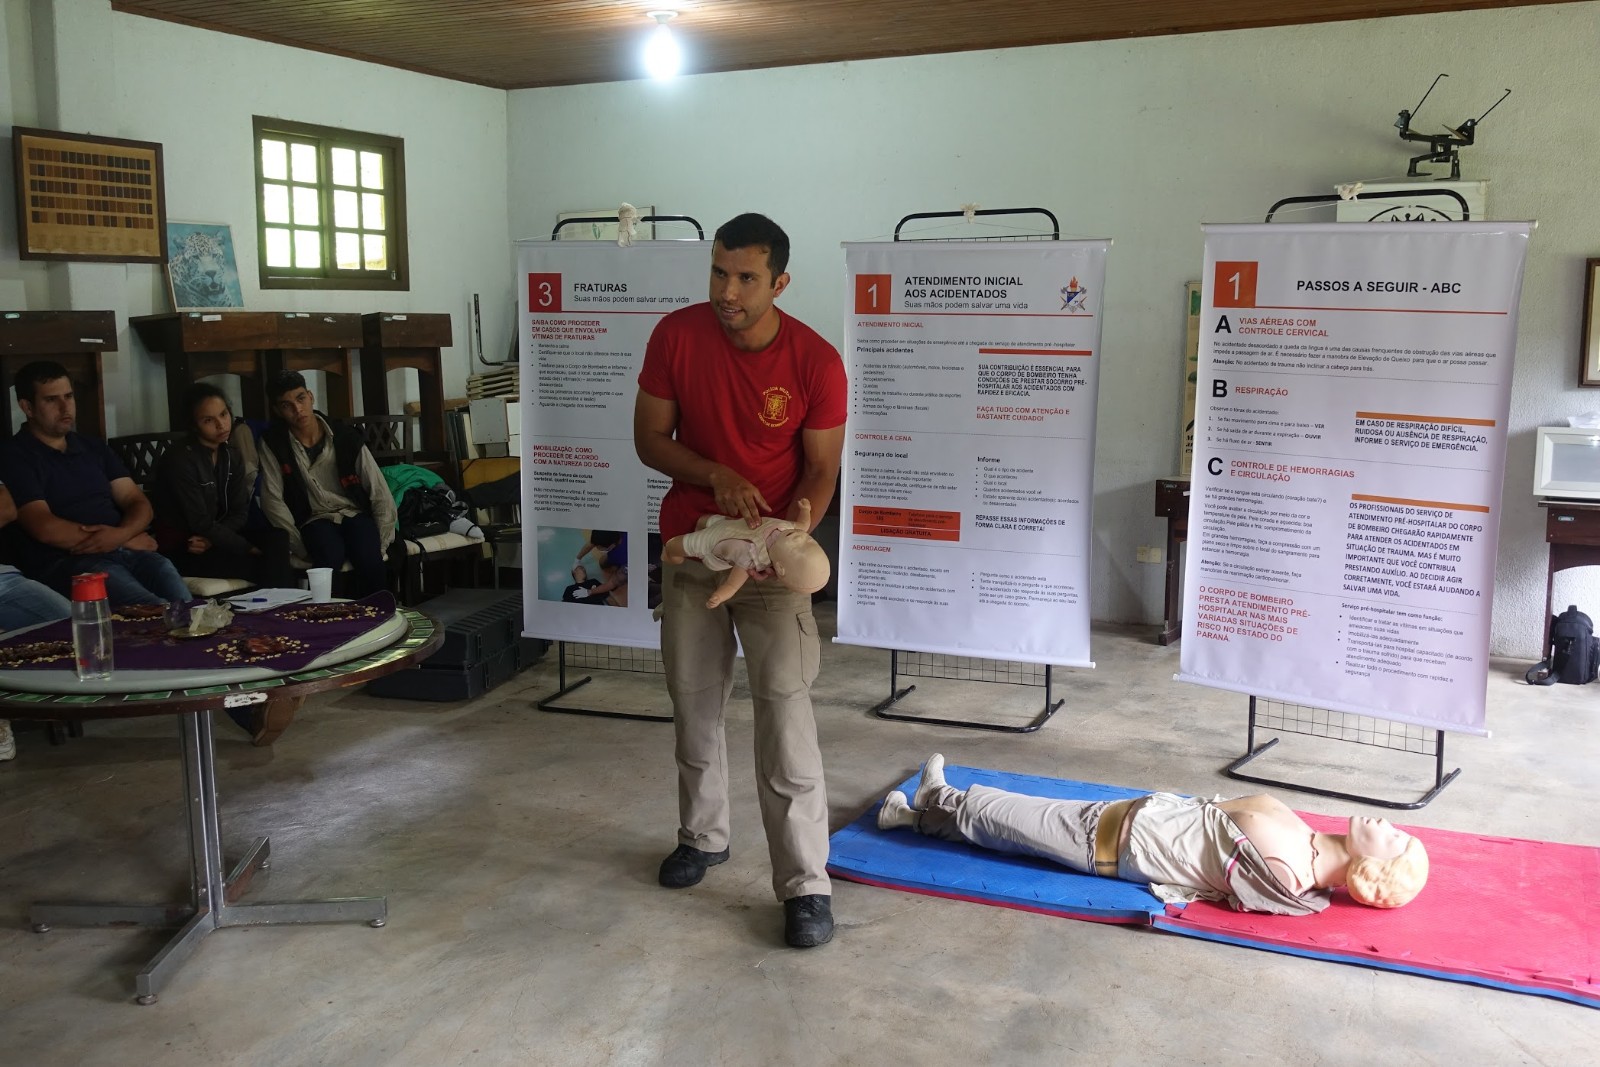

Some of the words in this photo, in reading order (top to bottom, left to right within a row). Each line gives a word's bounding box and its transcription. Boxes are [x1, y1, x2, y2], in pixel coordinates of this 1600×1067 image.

[574, 284, 627, 292] FRATURAS
[905, 277, 981, 285] ATENDIMENTO
[985, 277, 1023, 285] INICIAL
[1229, 272, 1240, 300] 1
[1297, 281, 1350, 291] PASSOS
[1353, 282, 1363, 291] A
[1367, 282, 1418, 292] SEGUIR
[1431, 283, 1461, 293] ABC
[539, 282, 552, 306] 3
[868, 284, 877, 307] 1
[905, 289, 926, 298] AOS
[930, 289, 1007, 298] ACIDENTADOS
[1215, 315, 1232, 333] A
[1260, 317, 1294, 326] AÉREAS
[1239, 327, 1283, 335] CONTROLE
[1286, 329, 1328, 337] CERVICAL
[1213, 379, 1227, 397] B
[1236, 387, 1288, 397] RESPIRAÇÃO
[1396, 422, 1439, 431] RESPIRAÇÃO
[1441, 423, 1466, 433] DIFÍCIL,
[1391, 439, 1419, 448] SERVIÇO
[1432, 442, 1478, 451] EMERGÊNCIA.
[1396, 431, 1429, 439] AUSÊNCIA
[1442, 434, 1488, 444] RESPIRAÇÃO,
[1208, 457, 1223, 476] C
[1231, 461, 1274, 470] CONTROLE
[1290, 466, 1354, 478] HEMORRAGIAS
[1238, 471, 1291, 482] CIRCULAÇÃO
[1359, 503, 1404, 514] PROFISSIONAIS
[1416, 509, 1443, 518] SERVIÇO
[1349, 513, 1393, 523] ATENDIMENTO
[1394, 517, 1447, 528] PRÉ-HOSPITALAR
[1460, 524, 1482, 532] CORPO
[1357, 524, 1390, 533] BOMBEIRO
[1391, 528, 1425, 537] CHEGARÃO
[1427, 532, 1473, 542] RAPIDAMENTE
[1208, 587, 1236, 596] CORPO
[1250, 593, 1294, 606] BOMBEIRO
[1199, 595, 1230, 605] PRESTA
[1232, 600, 1288, 614] ATENDIMENTO
[1291, 609, 1310, 617] PRÉ-
[1199, 604, 1248, 617] HOSPITALAR
[1250, 612, 1266, 620] NAS
[1268, 615, 1288, 624] MAIS
[1197, 622, 1221, 631] RISCO
[1237, 628, 1269, 639] ESTADO
[1198, 612, 1237, 624] VARIADAS
[1240, 619, 1284, 632] SITUAÇÕES
